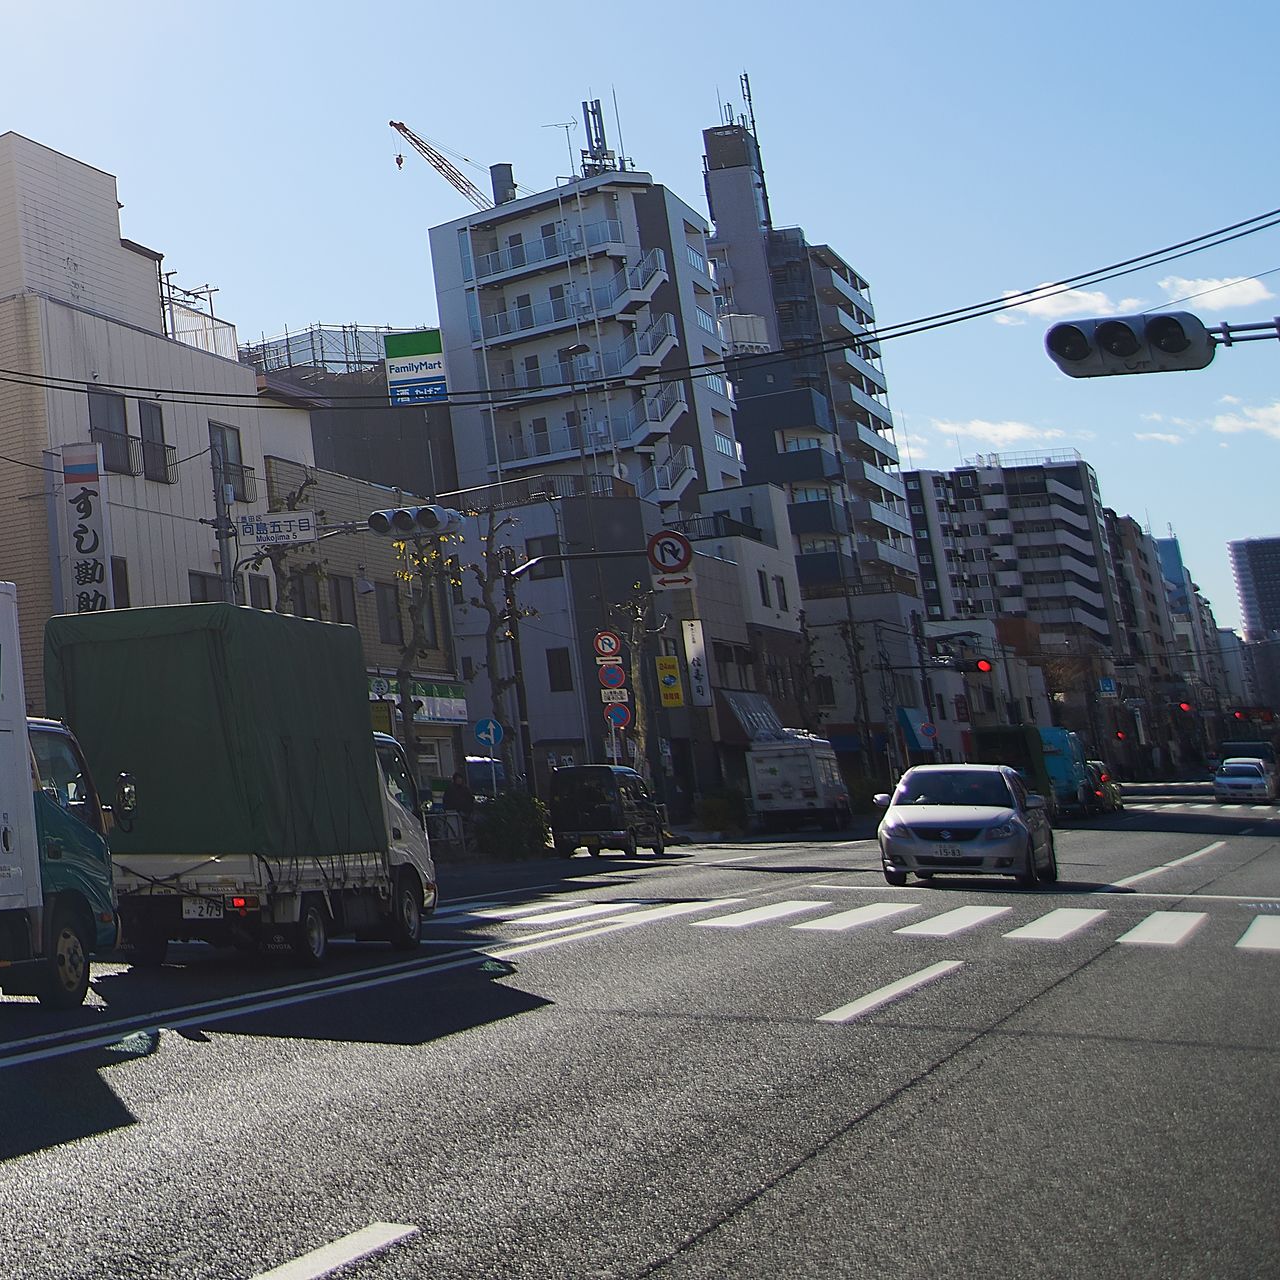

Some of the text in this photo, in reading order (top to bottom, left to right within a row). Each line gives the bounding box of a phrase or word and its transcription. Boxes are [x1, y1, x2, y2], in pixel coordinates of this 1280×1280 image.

[389, 361, 442, 374] FamilyMart
[396, 388, 411, 402] 酒
[242, 518, 310, 536] 向島五丁目
[256, 532, 298, 543] Mukojima 5
